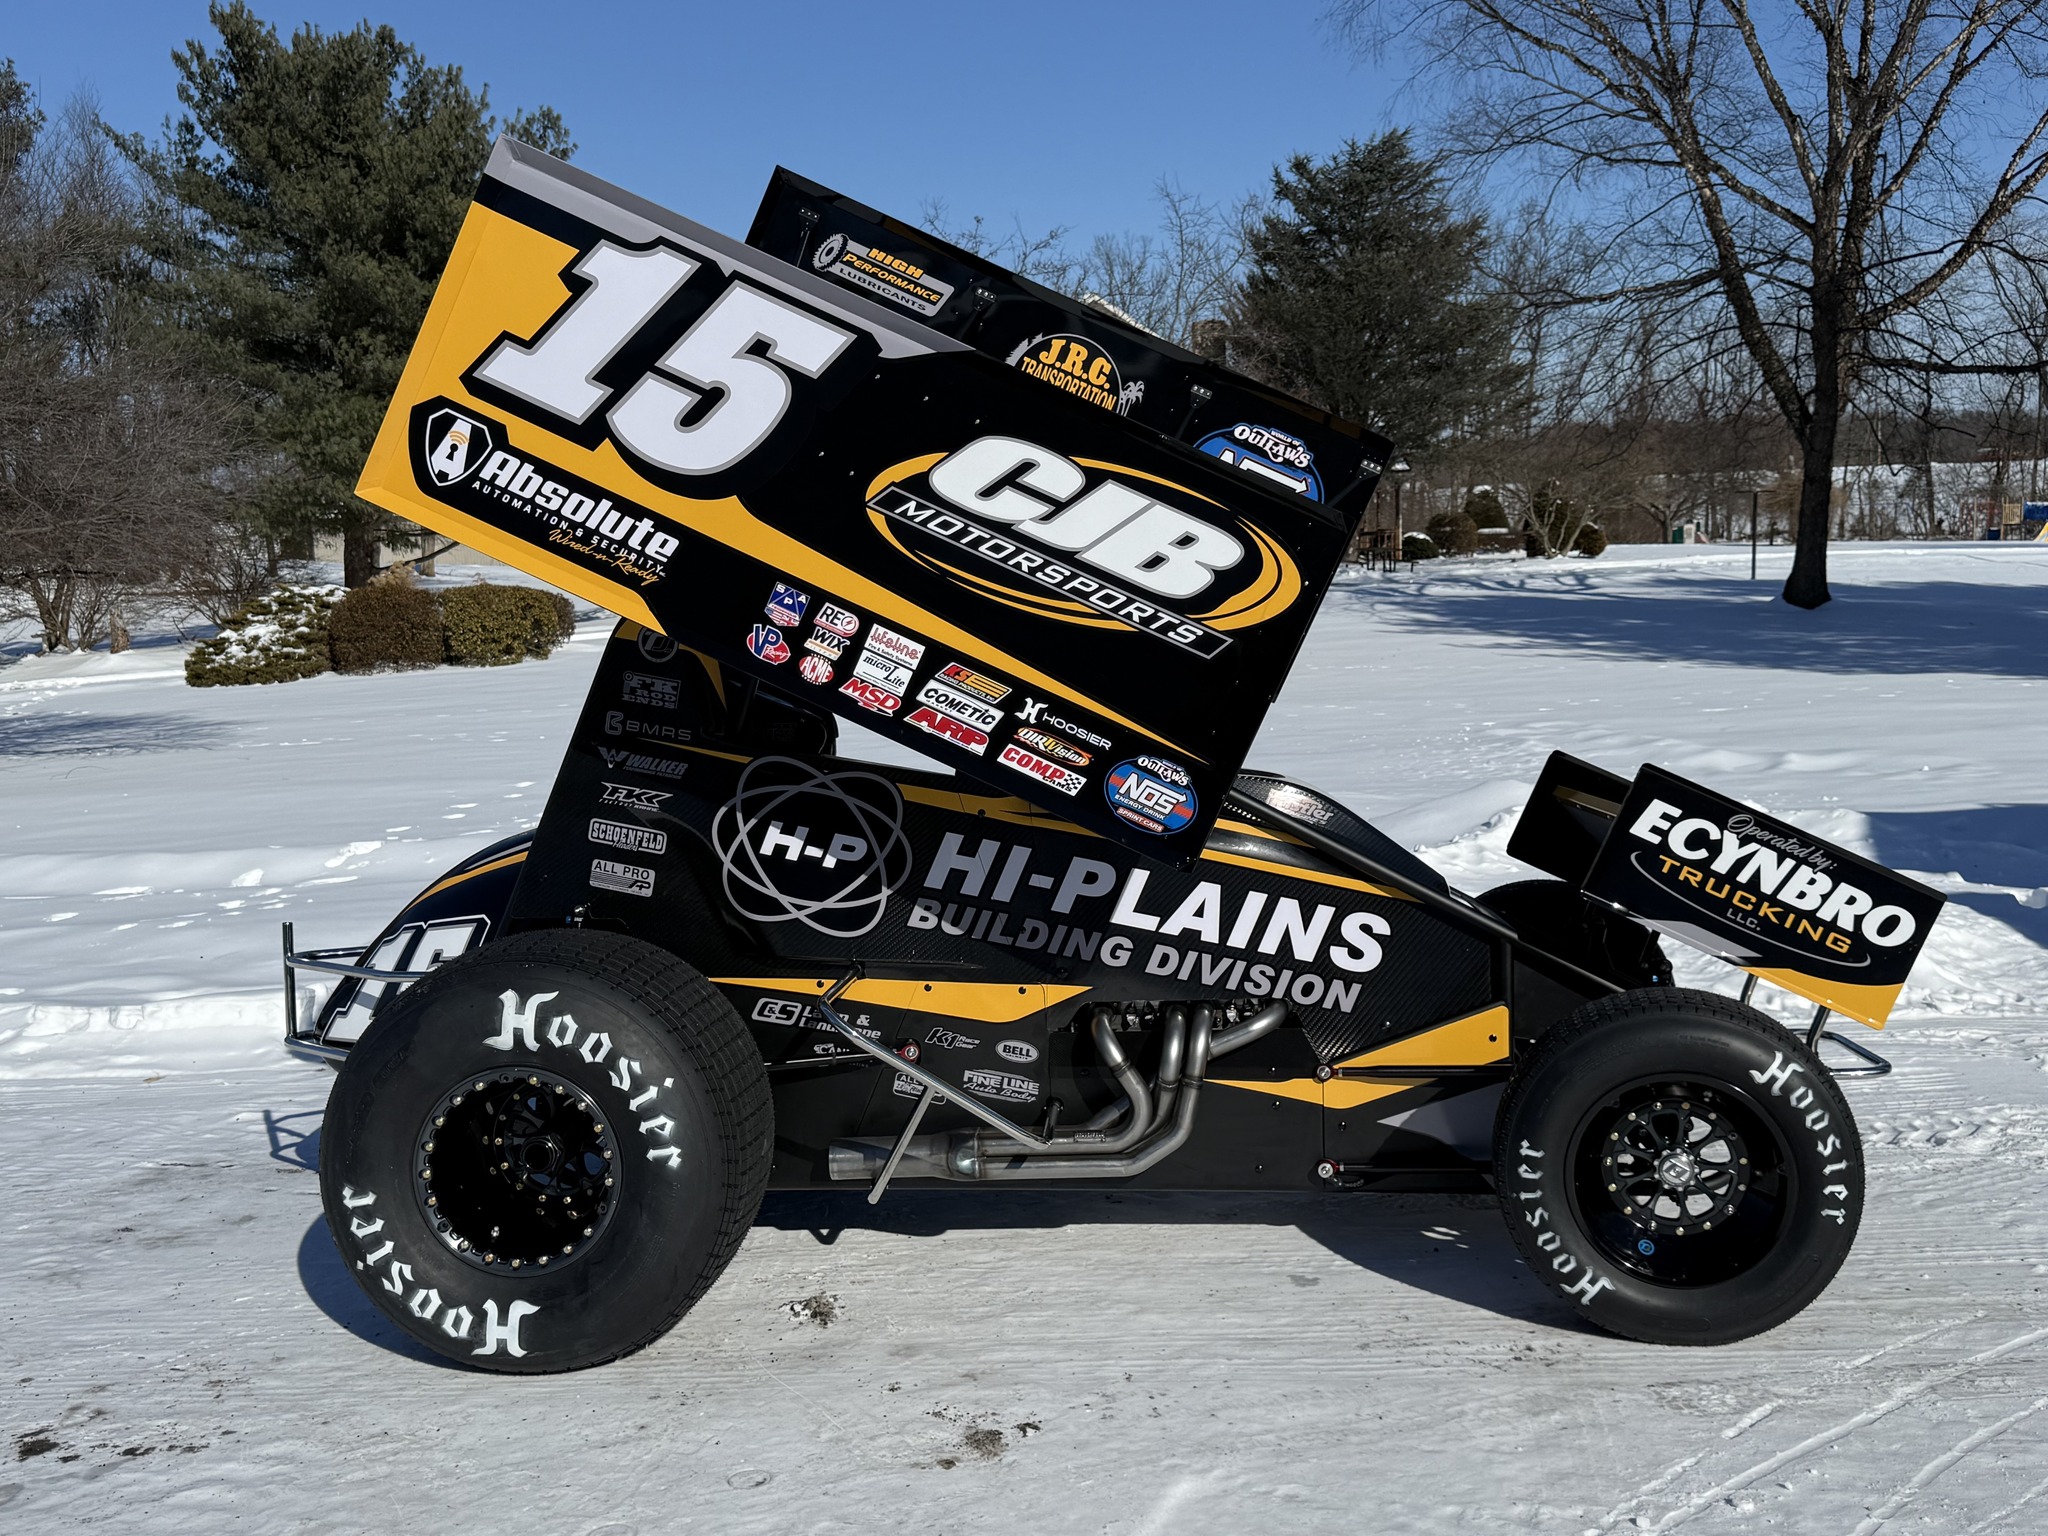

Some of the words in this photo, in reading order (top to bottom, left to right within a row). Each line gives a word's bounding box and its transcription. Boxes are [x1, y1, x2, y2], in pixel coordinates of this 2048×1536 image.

[843, 252, 940, 302] PERFORMANCE
[868, 248, 924, 279] HIGH
[840, 268, 926, 311] LUBRICANTS
[473, 239, 857, 476] 15
[1039, 338, 1112, 389] J.R.C.
[1021, 356, 1117, 410] TRANSPORTATION
[478, 450, 680, 563] Absolute
[928, 436, 1246, 600] CJB
[471, 481, 569, 530] AUTOMATION
[575, 527, 584, 538] &
[591, 535, 662, 573] SECURITY
[893, 501, 1205, 645] MOTORSPORTS
[814, 628, 848, 652] WIX
[800, 655, 832, 683] ACME
[842, 678, 899, 711] MSD
[925, 686, 997, 726] COMETIC
[626, 721, 691, 741] BMRS
[909, 708, 989, 747] ARP
[1042, 712, 1112, 750] HOOSIER
[626, 753, 688, 776] WALKER
[1003, 747, 1066, 781] COMP
[1114, 795, 1144, 811] ENERGY
[1143, 806, 1166, 820] DRINK
[1118, 772, 1187, 815] NOS
[592, 822, 664, 852] SCHOENFELD
[1117, 808, 1142, 823] SPRINT
[1143, 818, 1163, 832] CARS
[1727, 813, 1805, 860] Operated
[759, 820, 868, 869] H-P
[594, 862, 618, 875] ALL
[623, 866, 650, 880] PRO
[1628, 798, 1916, 948] ECYNBRO
[923, 831, 1391, 973] HI-PLAINS
[1659, 854, 1852, 955] TRUCKING
[1726, 908, 1761, 932] LLC.
[907, 898, 1133, 968] BUILDING
[1145, 943, 1362, 1014] DIVISION
[802, 1005, 850, 1023] Lan
[856, 1014, 871, 1027] &
[955, 1042, 978, 1050] Gear
[958, 1035, 981, 1045] Race
[1002, 1044, 1033, 1058] BELL
[482, 987, 684, 1170] Hoosier
[963, 1070, 1002, 1088] FINE
[1002, 1075, 1040, 1095] LINE
[964, 1082, 998, 1094] Auto
[1000, 1088, 1037, 1103] Body
[1748, 1050, 1850, 1226] Hoosier
[1513, 1138, 1616, 1306] Hoosier
[341, 1184, 542, 1358] Hoosier
